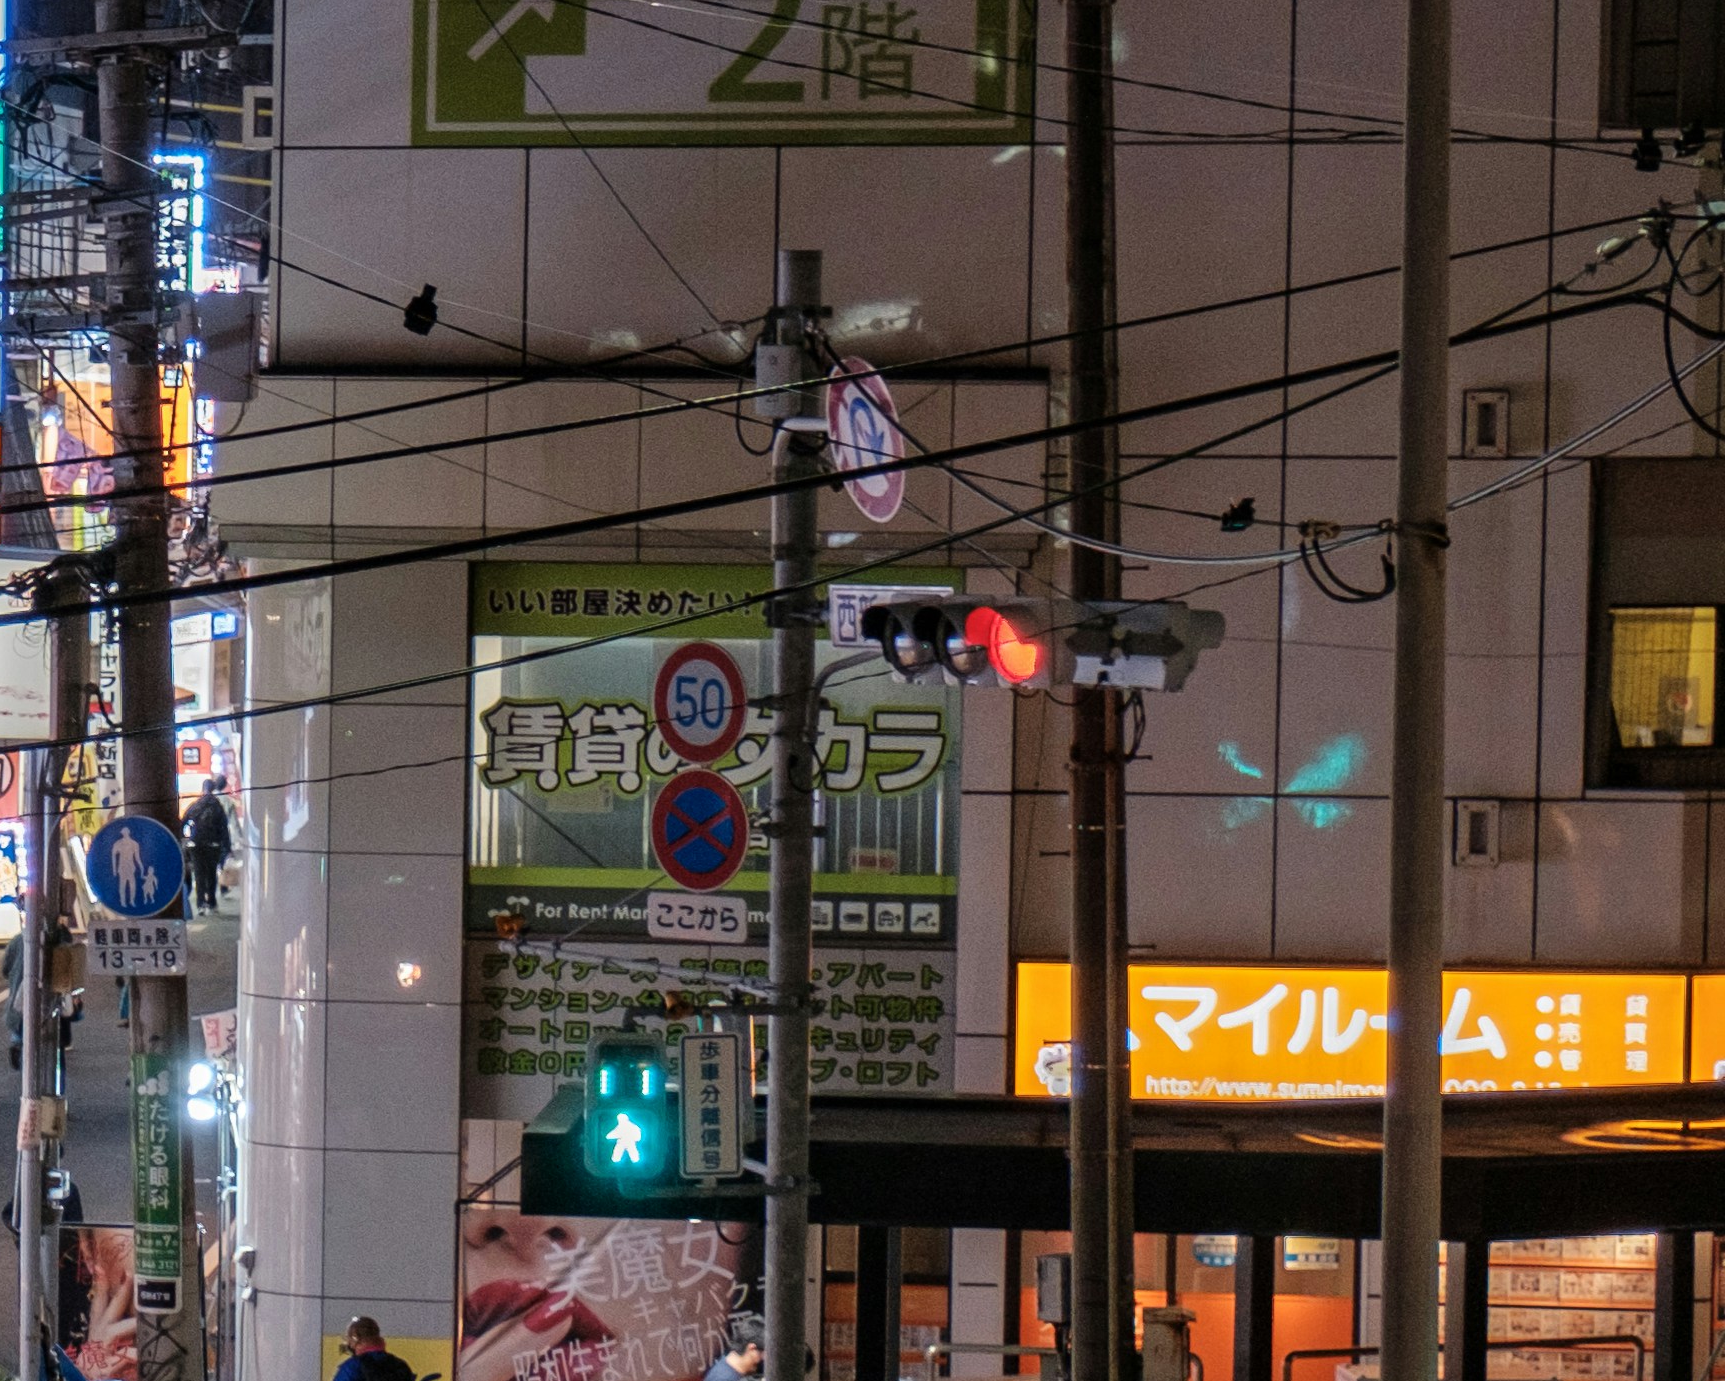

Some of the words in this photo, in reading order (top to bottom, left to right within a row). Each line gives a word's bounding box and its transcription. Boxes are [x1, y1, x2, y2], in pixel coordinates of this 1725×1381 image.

[674, 675, 726, 730] 50
[535, 903, 564, 920] For
[568, 904, 608, 920] Rent
[655, 902, 741, 934] ここから
[700, 1041, 722, 1170] 歩車分離信号
[150, 1100, 170, 1210] たける眼科
[543, 1219, 736, 1313] 美魔女
